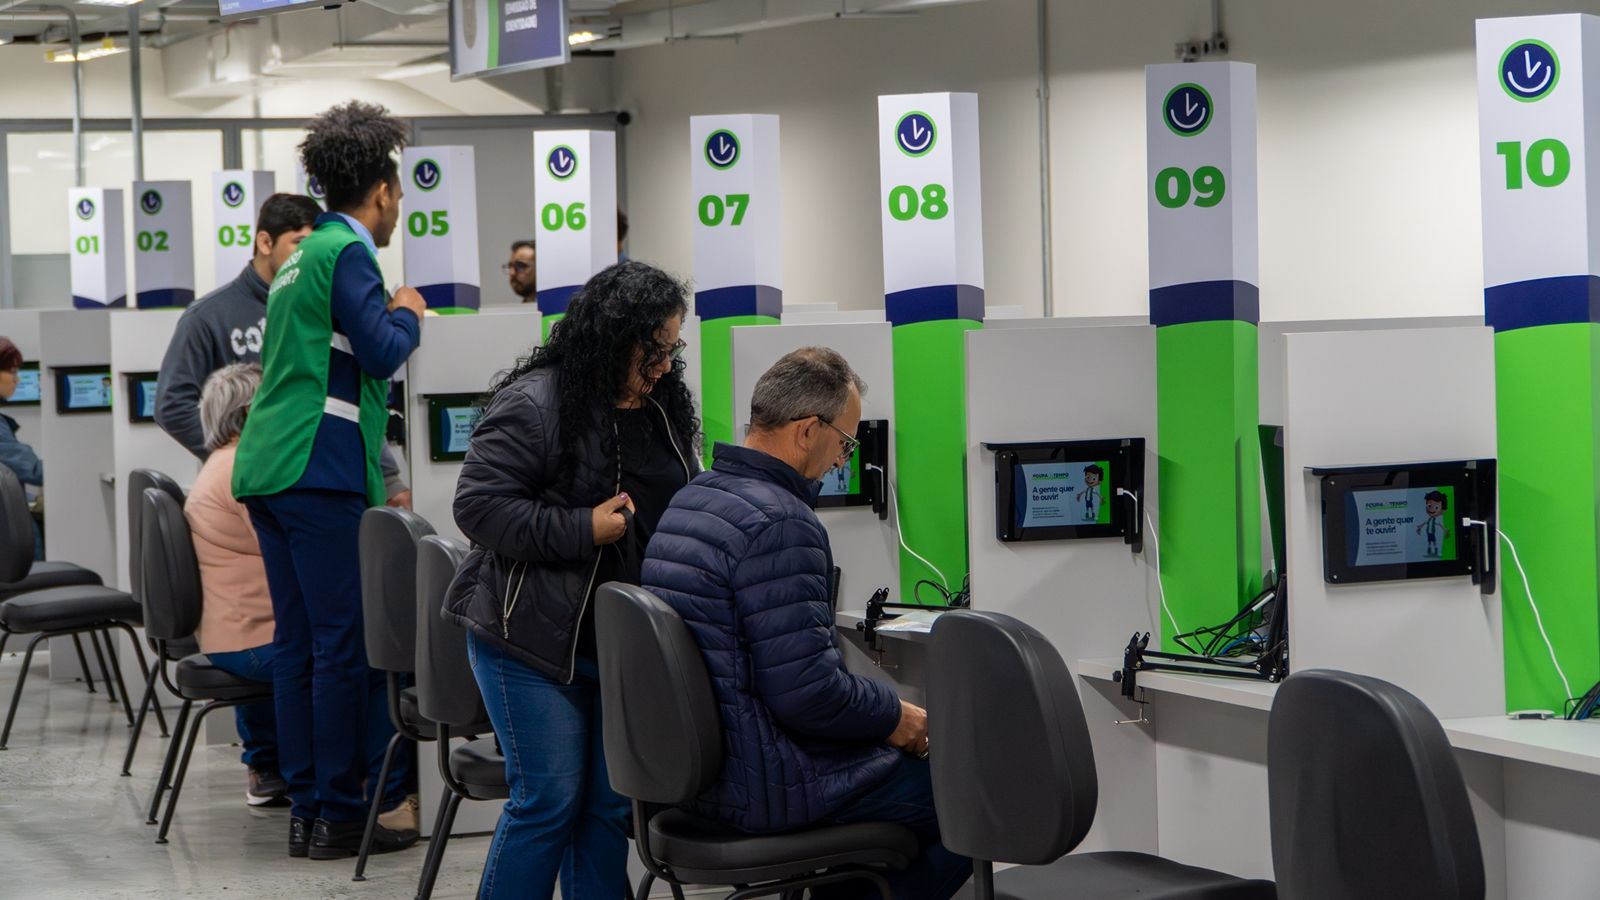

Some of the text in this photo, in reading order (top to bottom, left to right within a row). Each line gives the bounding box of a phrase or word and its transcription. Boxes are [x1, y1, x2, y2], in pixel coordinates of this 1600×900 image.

[1496, 138, 1571, 190] 10
[1154, 165, 1226, 209] 09
[698, 193, 750, 227] 07
[888, 183, 949, 221] 08
[407, 210, 449, 237] 05
[541, 202, 586, 231] 06
[76, 236, 99, 254] 01
[137, 230, 169, 252] 02
[218, 224, 251, 247] 03
[1039, 486, 1058, 495] gente
[1059, 486, 1075, 494] quer
[1040, 493, 1059, 501] ouvir!
[1366, 516, 1414, 527] A gente quer
[1366, 525, 1397, 535] te ouvir!
